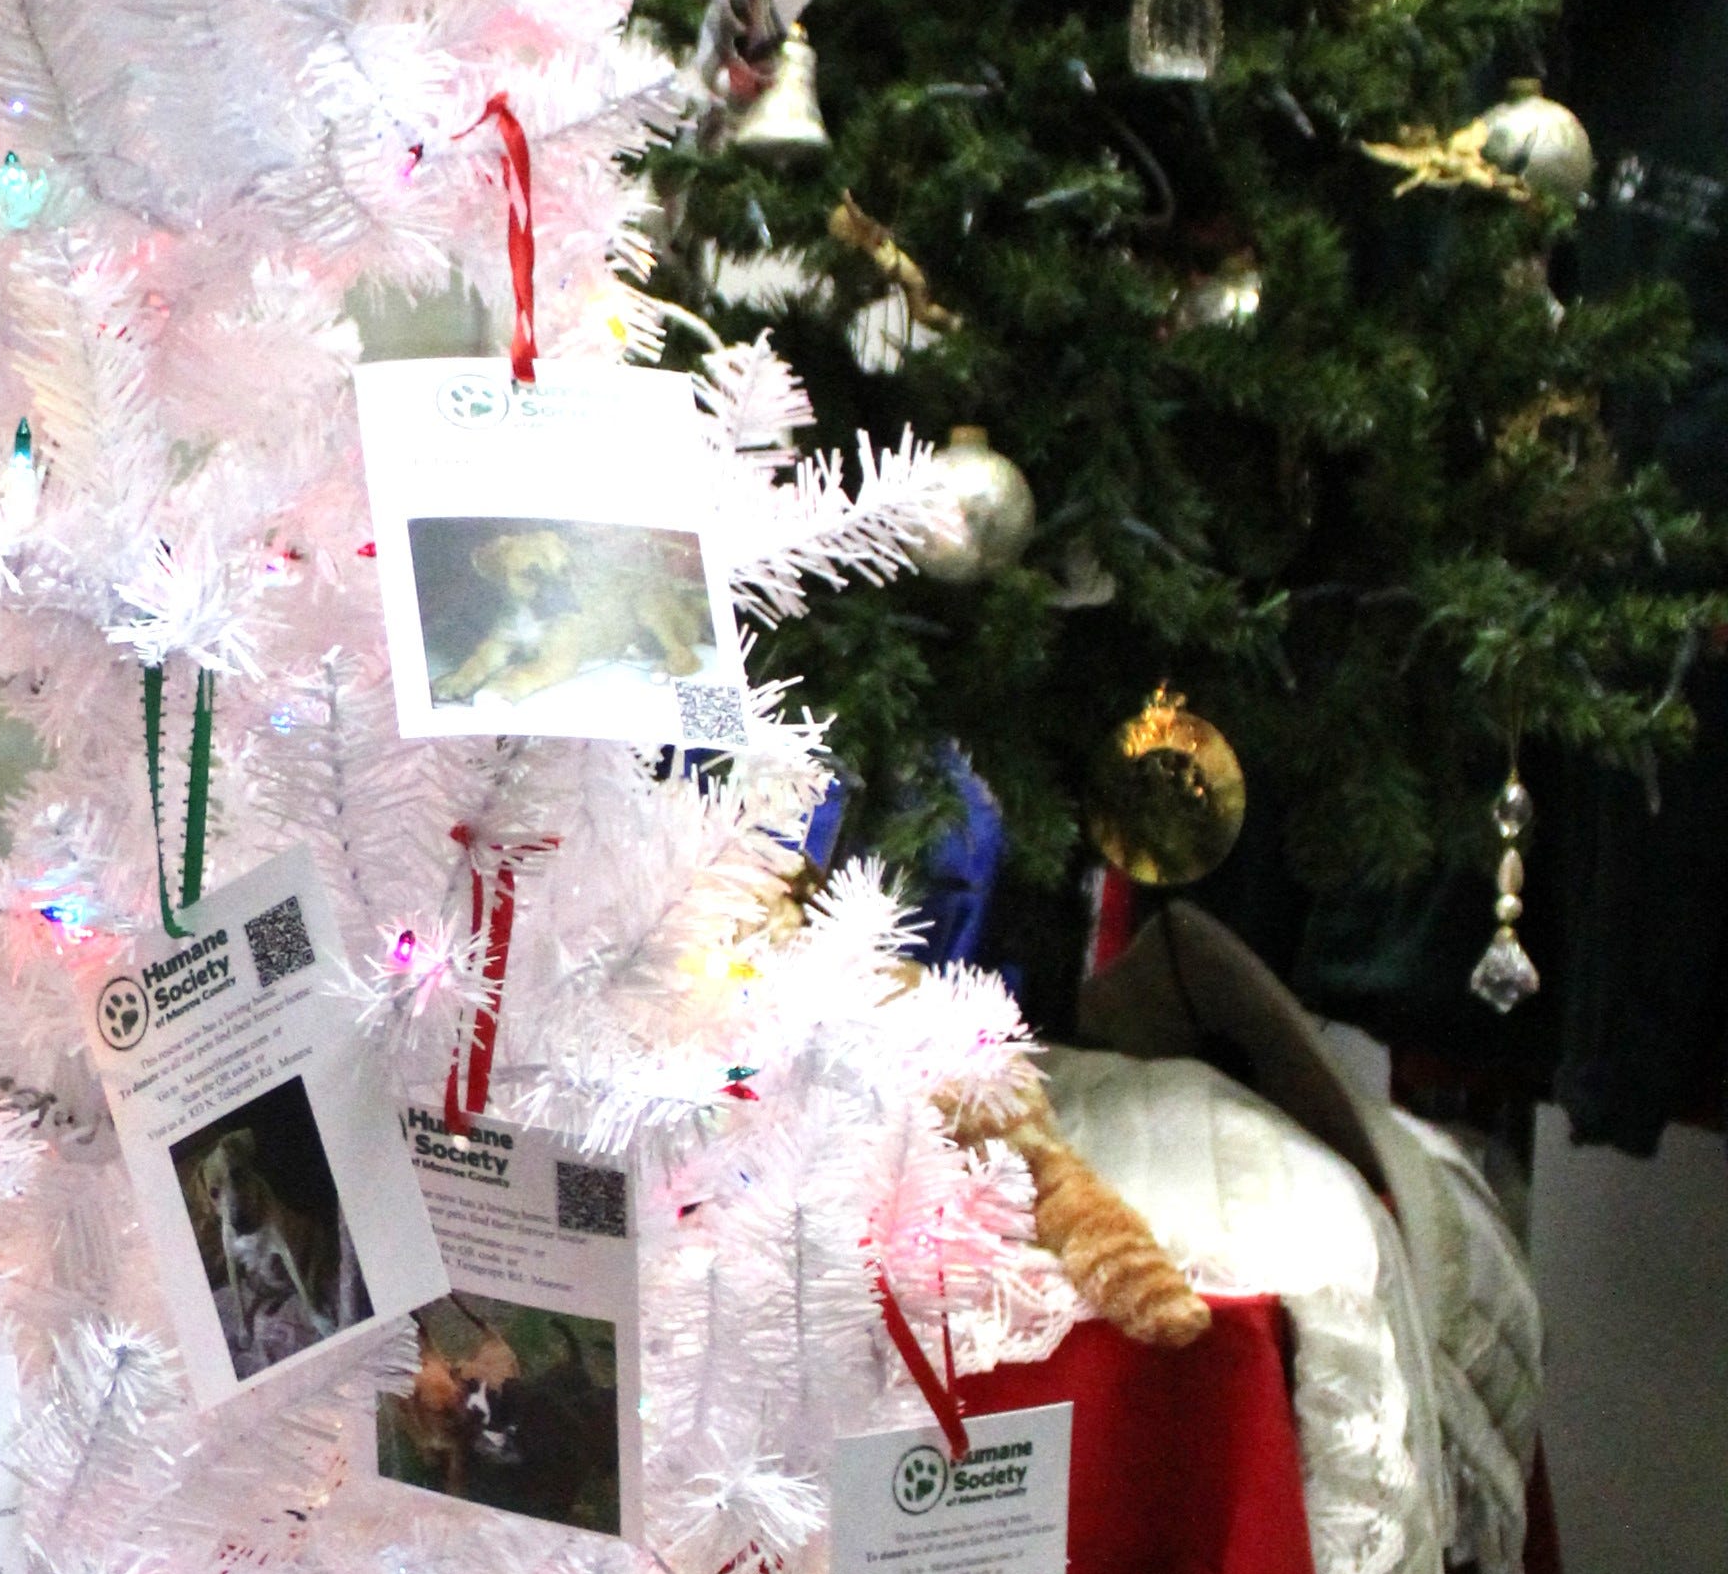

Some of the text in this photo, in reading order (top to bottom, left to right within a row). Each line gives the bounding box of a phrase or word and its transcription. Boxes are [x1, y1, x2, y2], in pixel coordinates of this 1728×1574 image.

[141, 928, 228, 989] Humane
[153, 954, 230, 1011] Society
[407, 1106, 513, 1150] Huane
